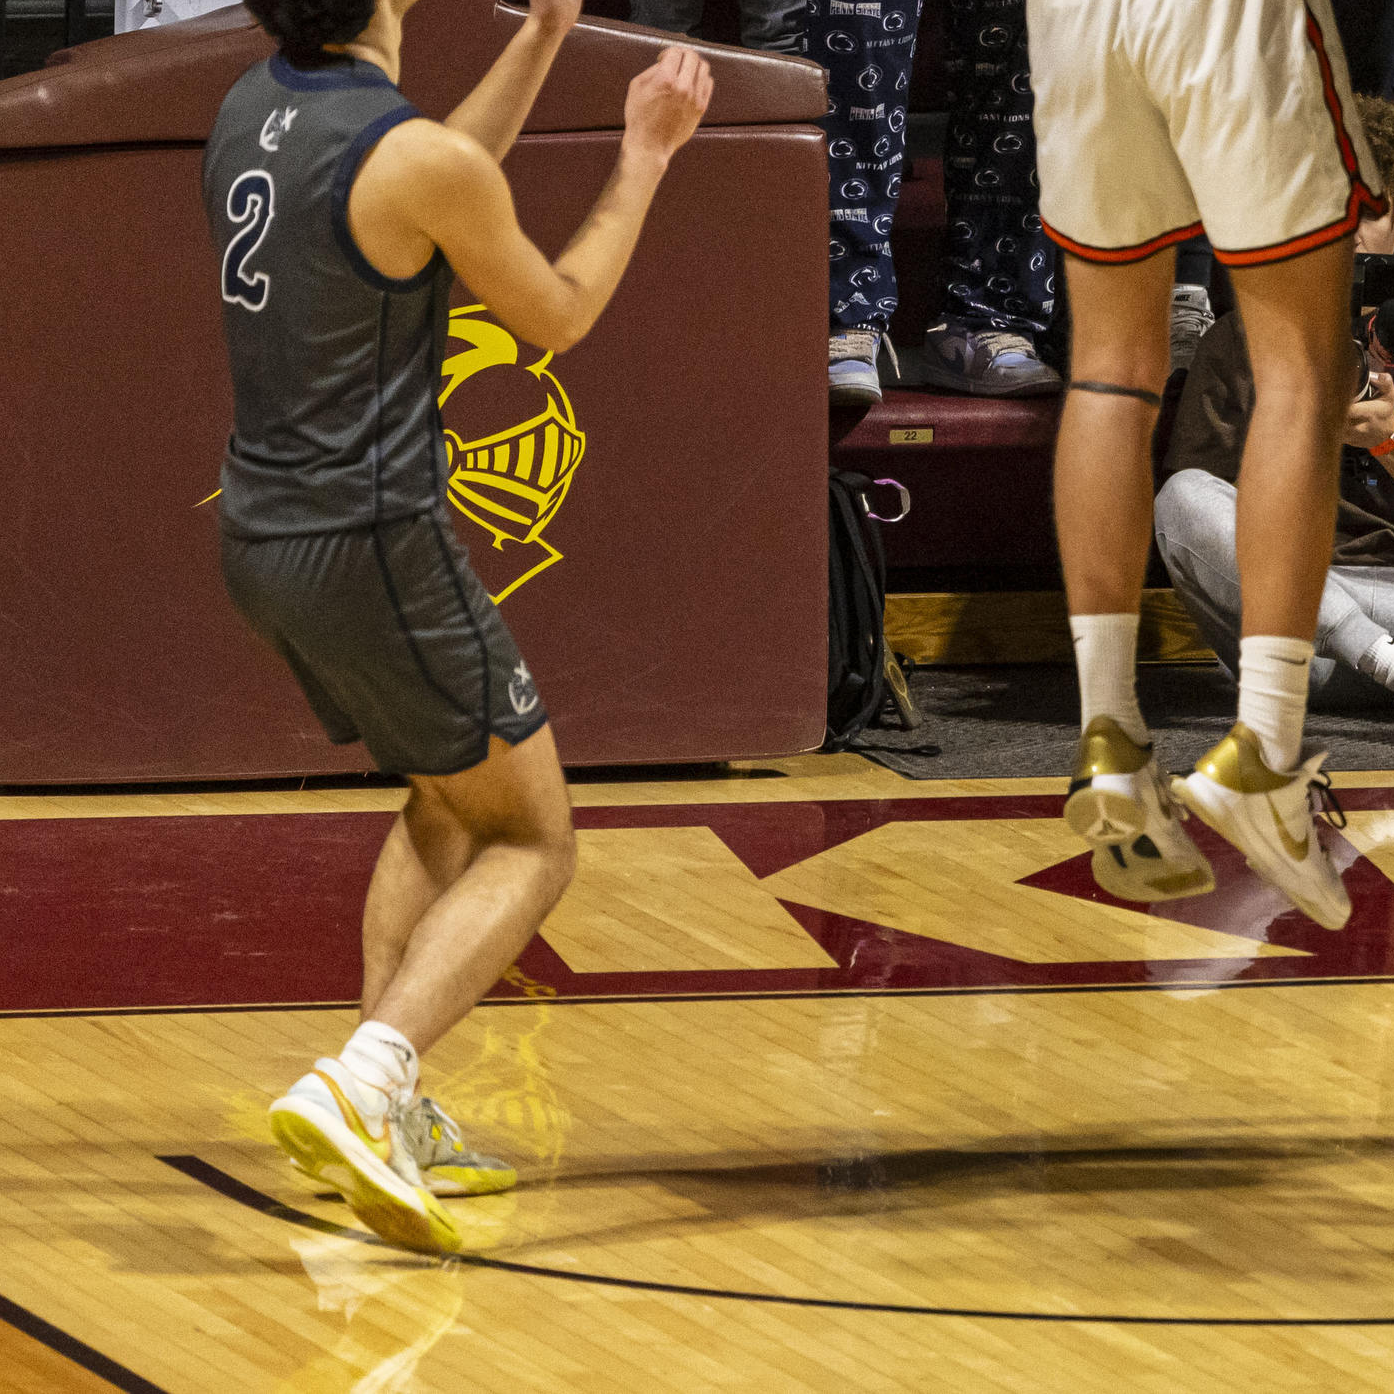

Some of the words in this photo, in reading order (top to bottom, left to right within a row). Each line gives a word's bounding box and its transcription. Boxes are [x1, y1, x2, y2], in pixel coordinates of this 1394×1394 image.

[829, 0, 855, 15] PENN
[856, 2, 882, 18] STATE
[222, 168, 276, 313] 2
[903, 430, 918, 441] 22
